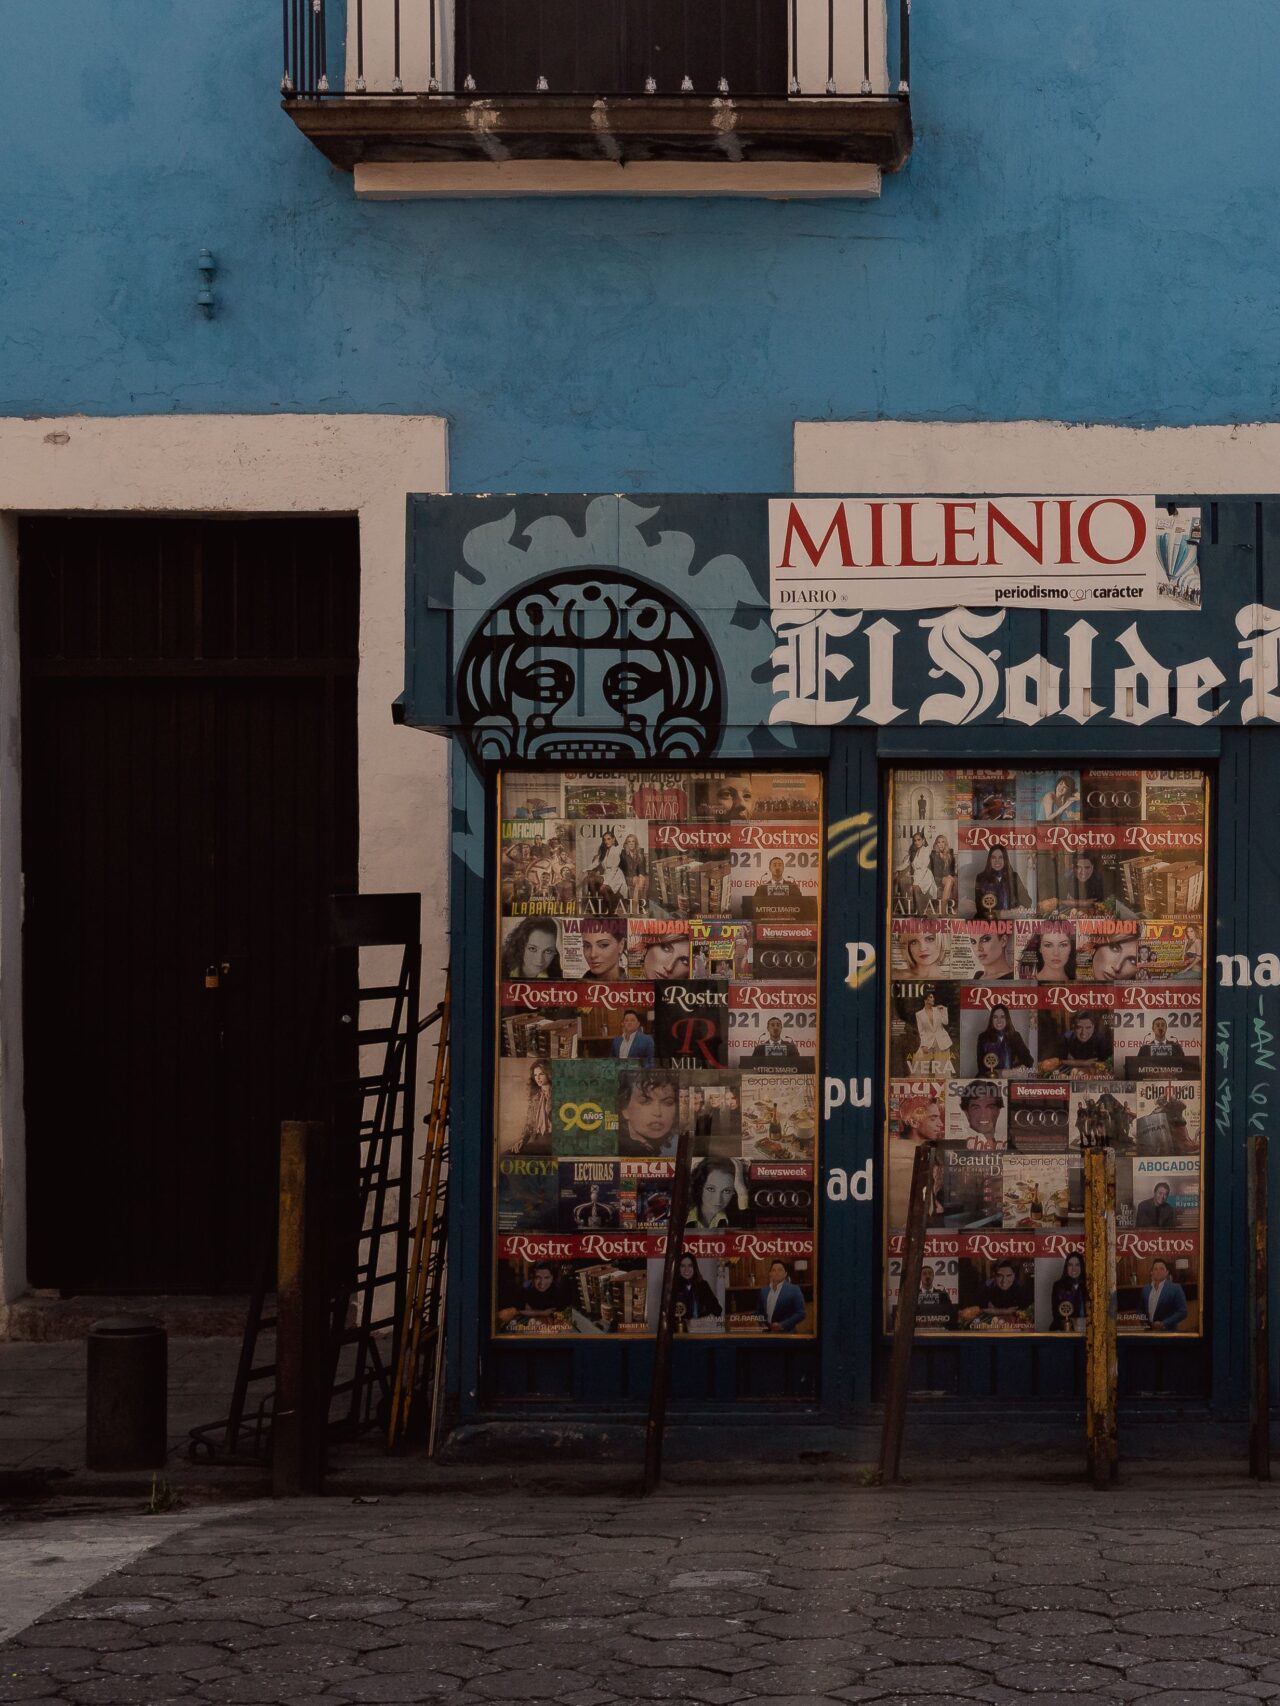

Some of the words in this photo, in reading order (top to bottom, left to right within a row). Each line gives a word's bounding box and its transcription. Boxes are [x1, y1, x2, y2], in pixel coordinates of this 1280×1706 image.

[776, 498, 1147, 568] MILENIO
[780, 589, 837, 604] DIARIO
[768, 608, 909, 726] El
[645, 800, 681, 820] AMOR
[740, 826, 819, 850] Rostros
[968, 827, 1037, 851] Rostro
[1047, 827, 1116, 853] Rostro
[1126, 826, 1203, 853] Rostros
[614, 899, 649, 914] AIR
[894, 899, 919, 915] AL
[923, 899, 958, 915] AIR
[762, 927, 813, 938] Newsweek
[508, 983, 578, 1010] Rostro
[739, 986, 818, 1010] Rostros
[970, 987, 1039, 1011] Rostro
[1048, 986, 1115, 1013] Rostro
[1124, 987, 1201, 1011] Rostros
[906, 1061, 957, 1074] VERA
[1016, 1086, 1066, 1096] Newsweek
[559, 1102, 603, 1131] 90
[574, 1162, 614, 1182] LECTURAS
[757, 1167, 808, 1177] Newsweek
[827, 1158, 874, 1201] ad
[735, 1234, 814, 1261] Rostros
[1117, 1233, 1195, 1260] Rostros
